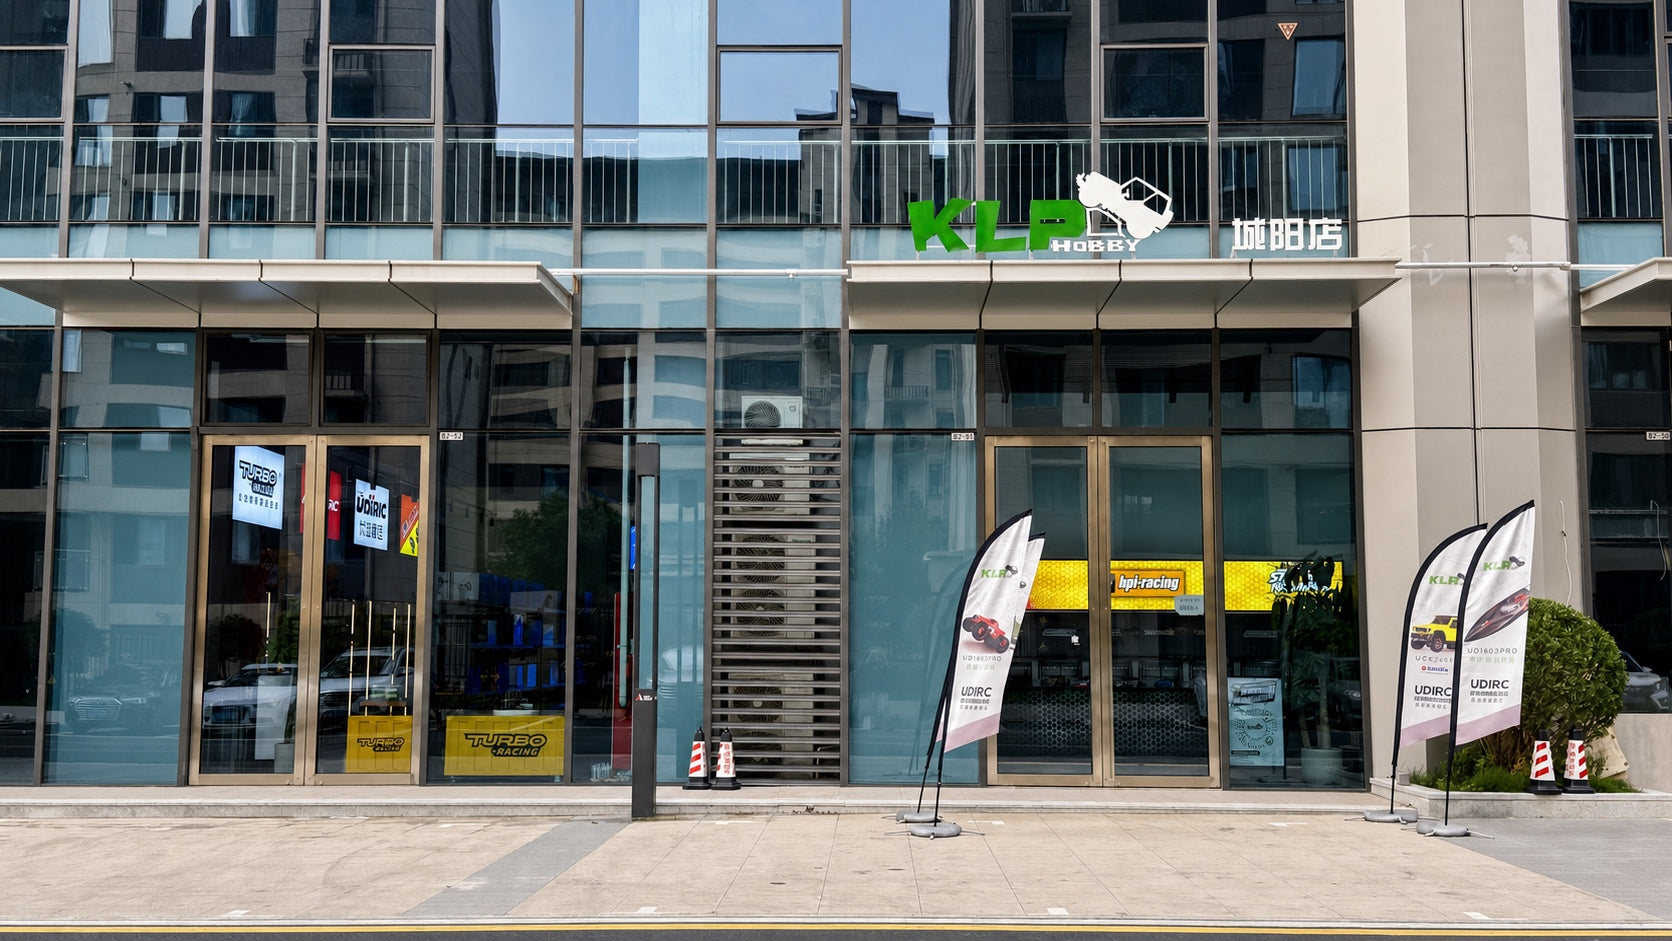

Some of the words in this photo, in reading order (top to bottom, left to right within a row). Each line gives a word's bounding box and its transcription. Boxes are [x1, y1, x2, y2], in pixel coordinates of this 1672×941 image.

[907, 198, 1087, 252] KLP
[1231, 217, 1343, 251] 城阳店
[1051, 239, 1141, 252] HOBBY
[239, 459, 278, 487] TURBO
[1470, 679, 1510, 690] UDIRC
[961, 686, 993, 698] UDIRC
[1414, 685, 1452, 697] UDIRC
[357, 737, 405, 748] TURBO
[464, 733, 548, 748] TURBO
[494, 747, 541, 757] RACING
